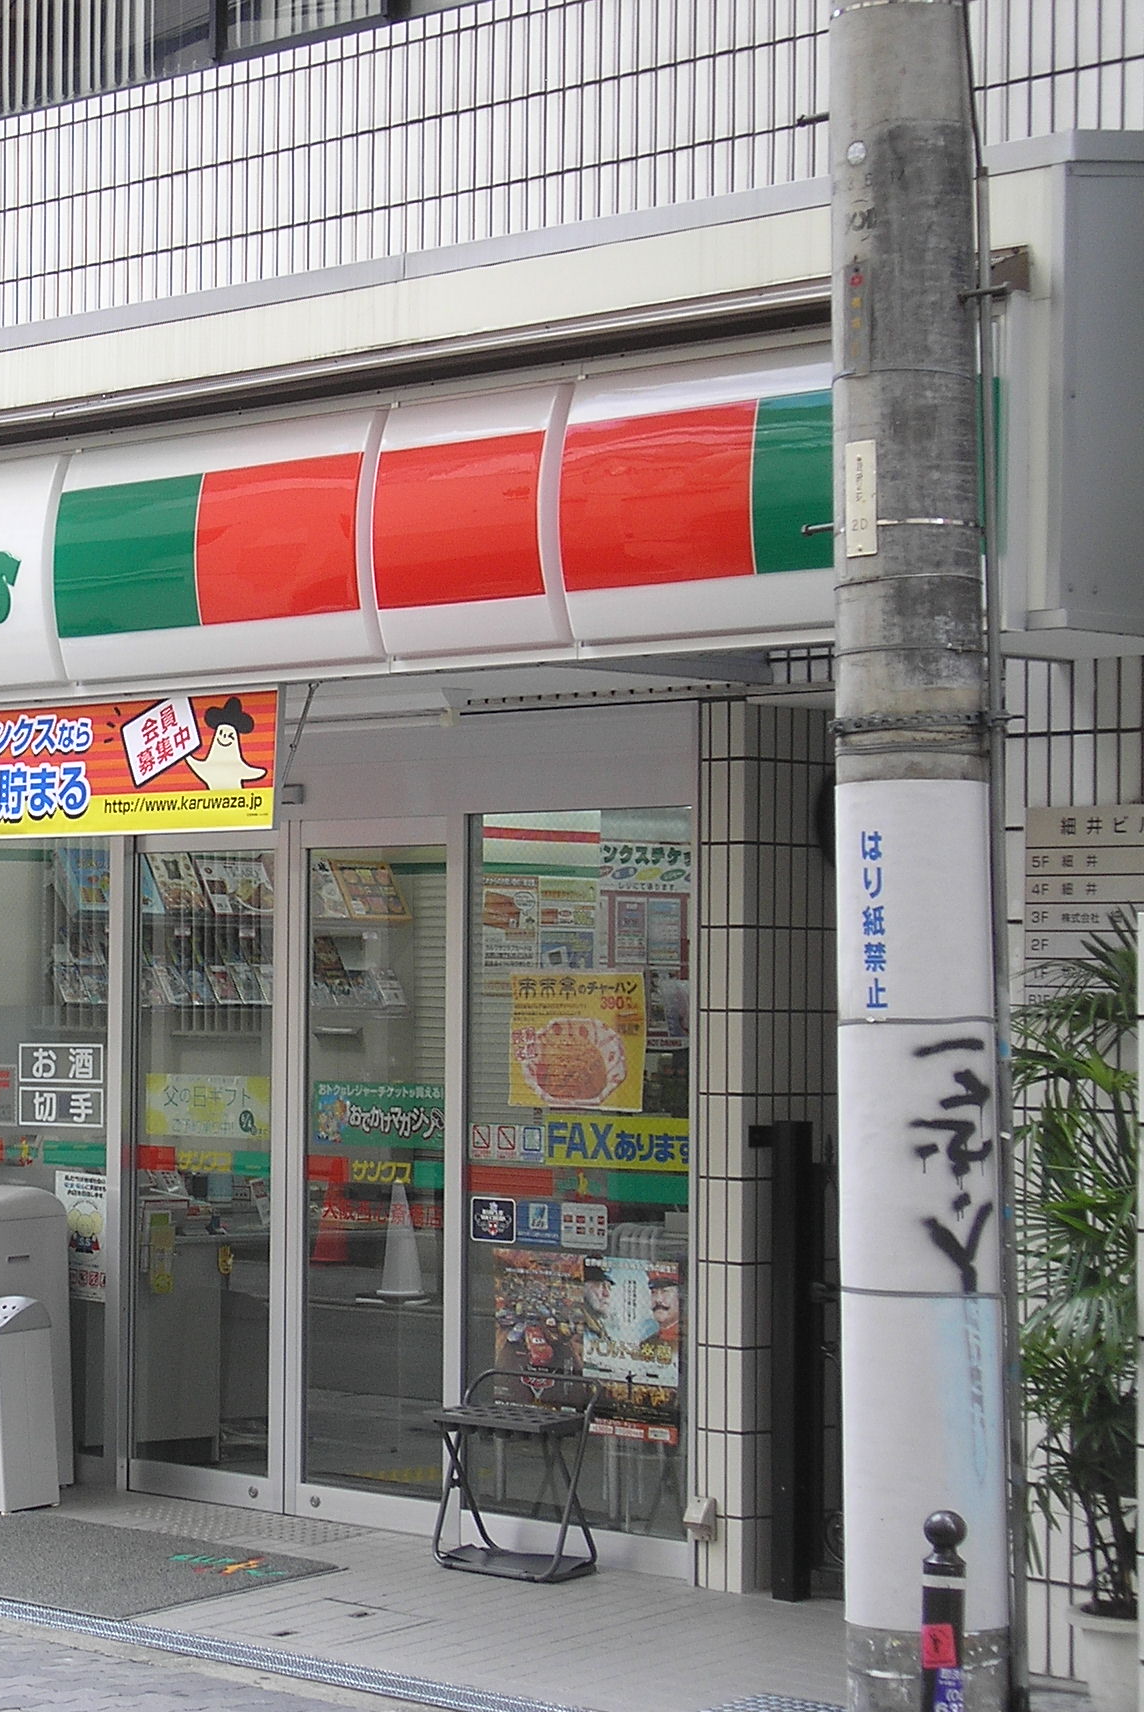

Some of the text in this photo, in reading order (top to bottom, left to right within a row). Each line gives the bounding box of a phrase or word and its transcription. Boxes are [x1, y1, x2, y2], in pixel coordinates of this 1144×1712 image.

[140, 703, 179, 746] 会員
[136, 725, 192, 777] 募集中
[103, 792, 263, 816] http://www.karuwaza.jp
[1059, 815, 1144, 837] 細井ビ
[1031, 855, 1050, 869] 5F
[1031, 883, 1050, 896] 4F
[860, 830, 888, 1009] はり紙禁止
[1031, 910, 1049, 924] 3F
[1061, 912, 1101, 925] 株式会社
[1031, 938, 1049, 951] 2F
[31, 1047, 94, 1079] お酒
[32, 1091, 94, 1123] 切手
